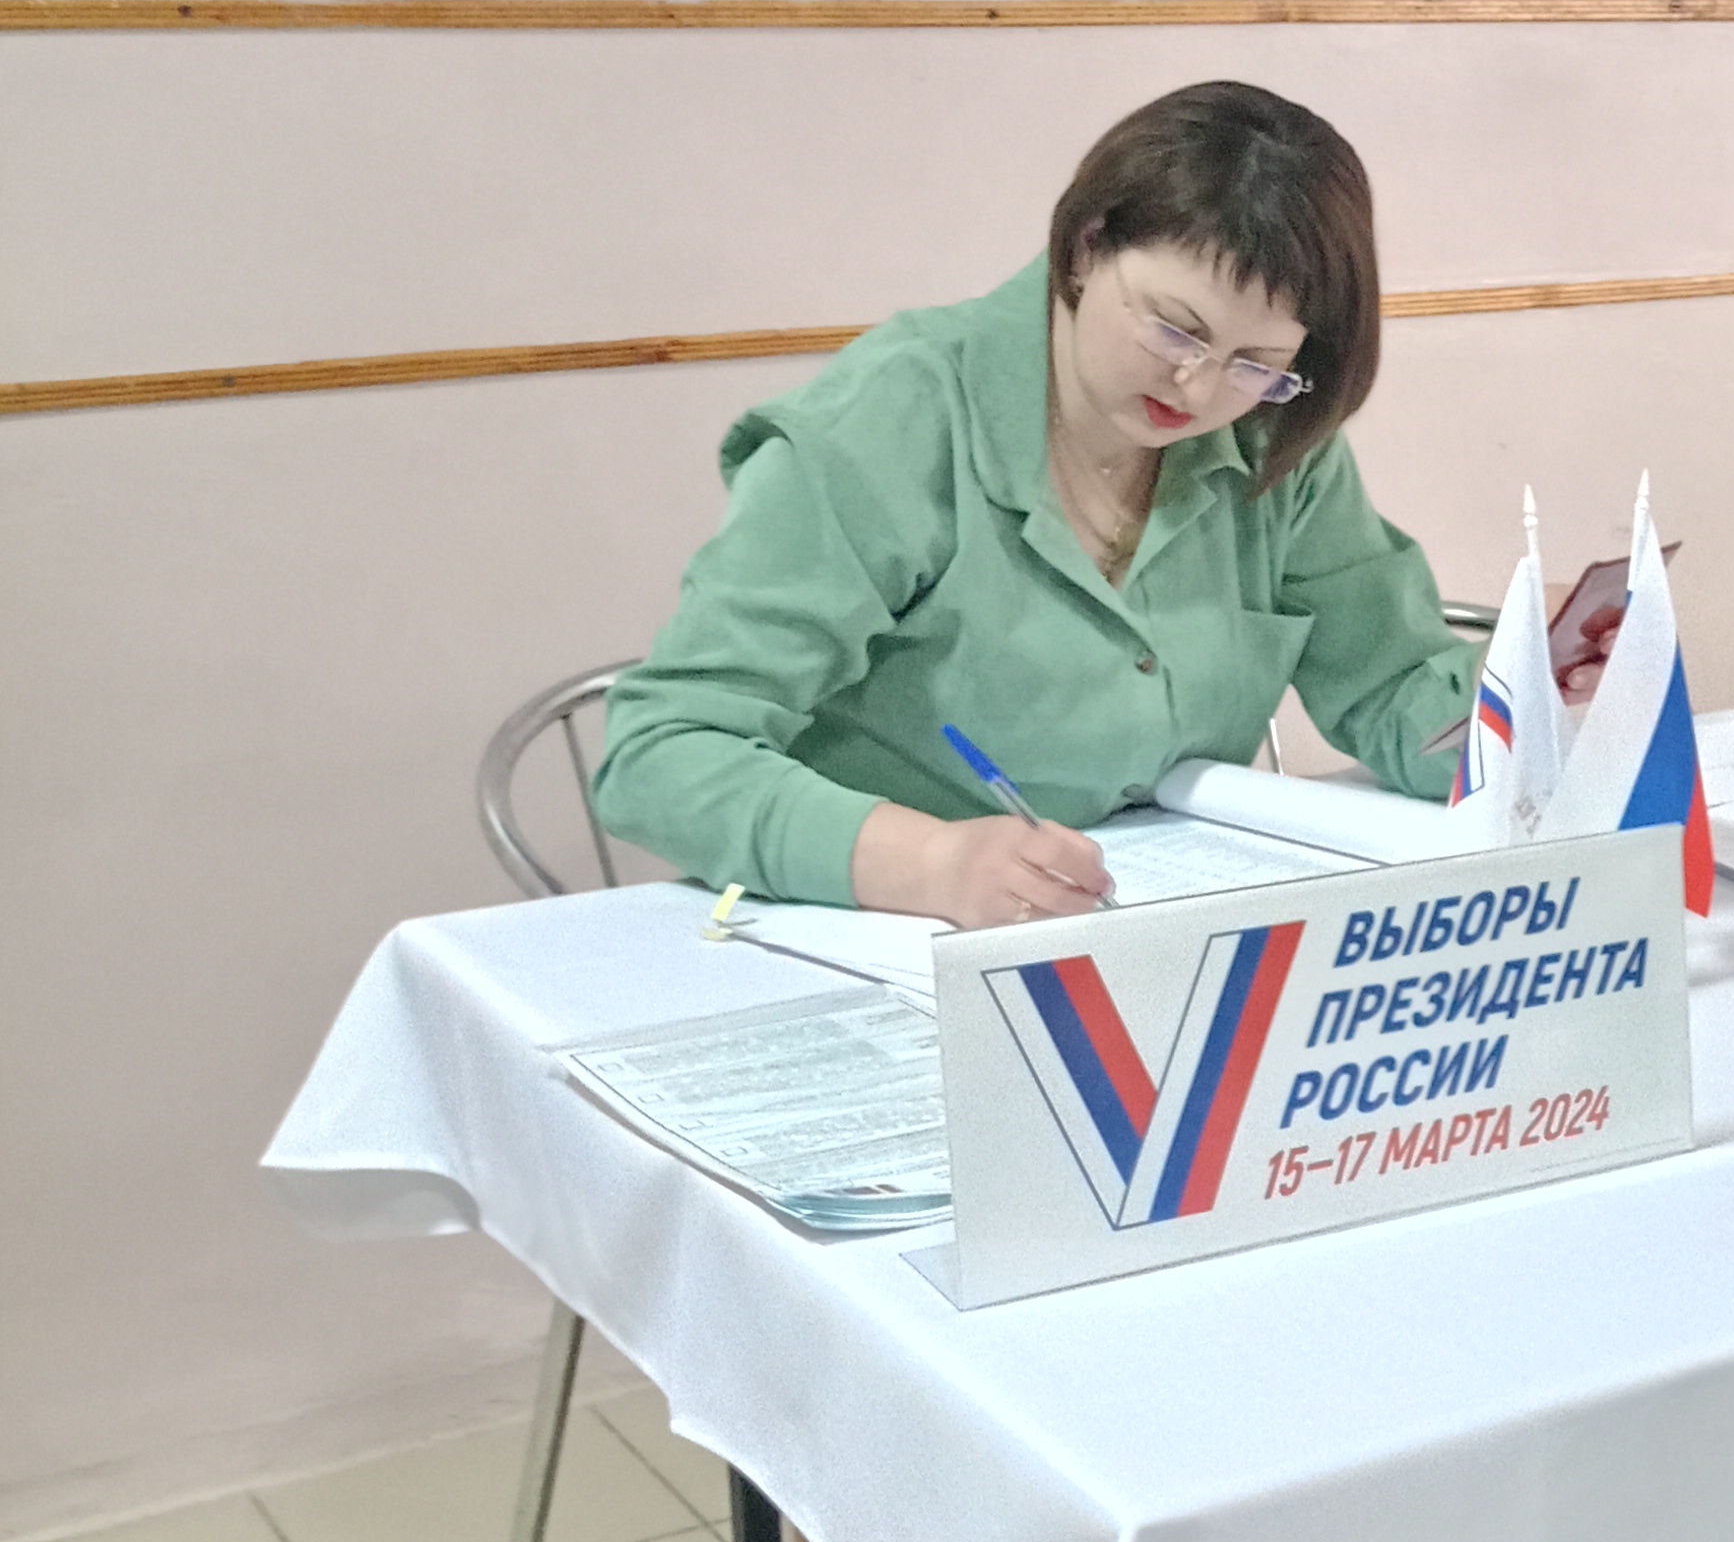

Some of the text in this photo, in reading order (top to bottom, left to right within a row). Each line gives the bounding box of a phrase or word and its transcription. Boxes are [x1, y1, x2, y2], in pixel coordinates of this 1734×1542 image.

[1333, 876, 1581, 969] ВЫБОРЫ
[1305, 937, 1650, 1049] ПРЕЗИДЕНТА
[1279, 1034, 1511, 1129] РОССИИ
[1378, 1104, 1512, 1177] МАРТА
[1518, 1085, 1611, 1149] 2024
